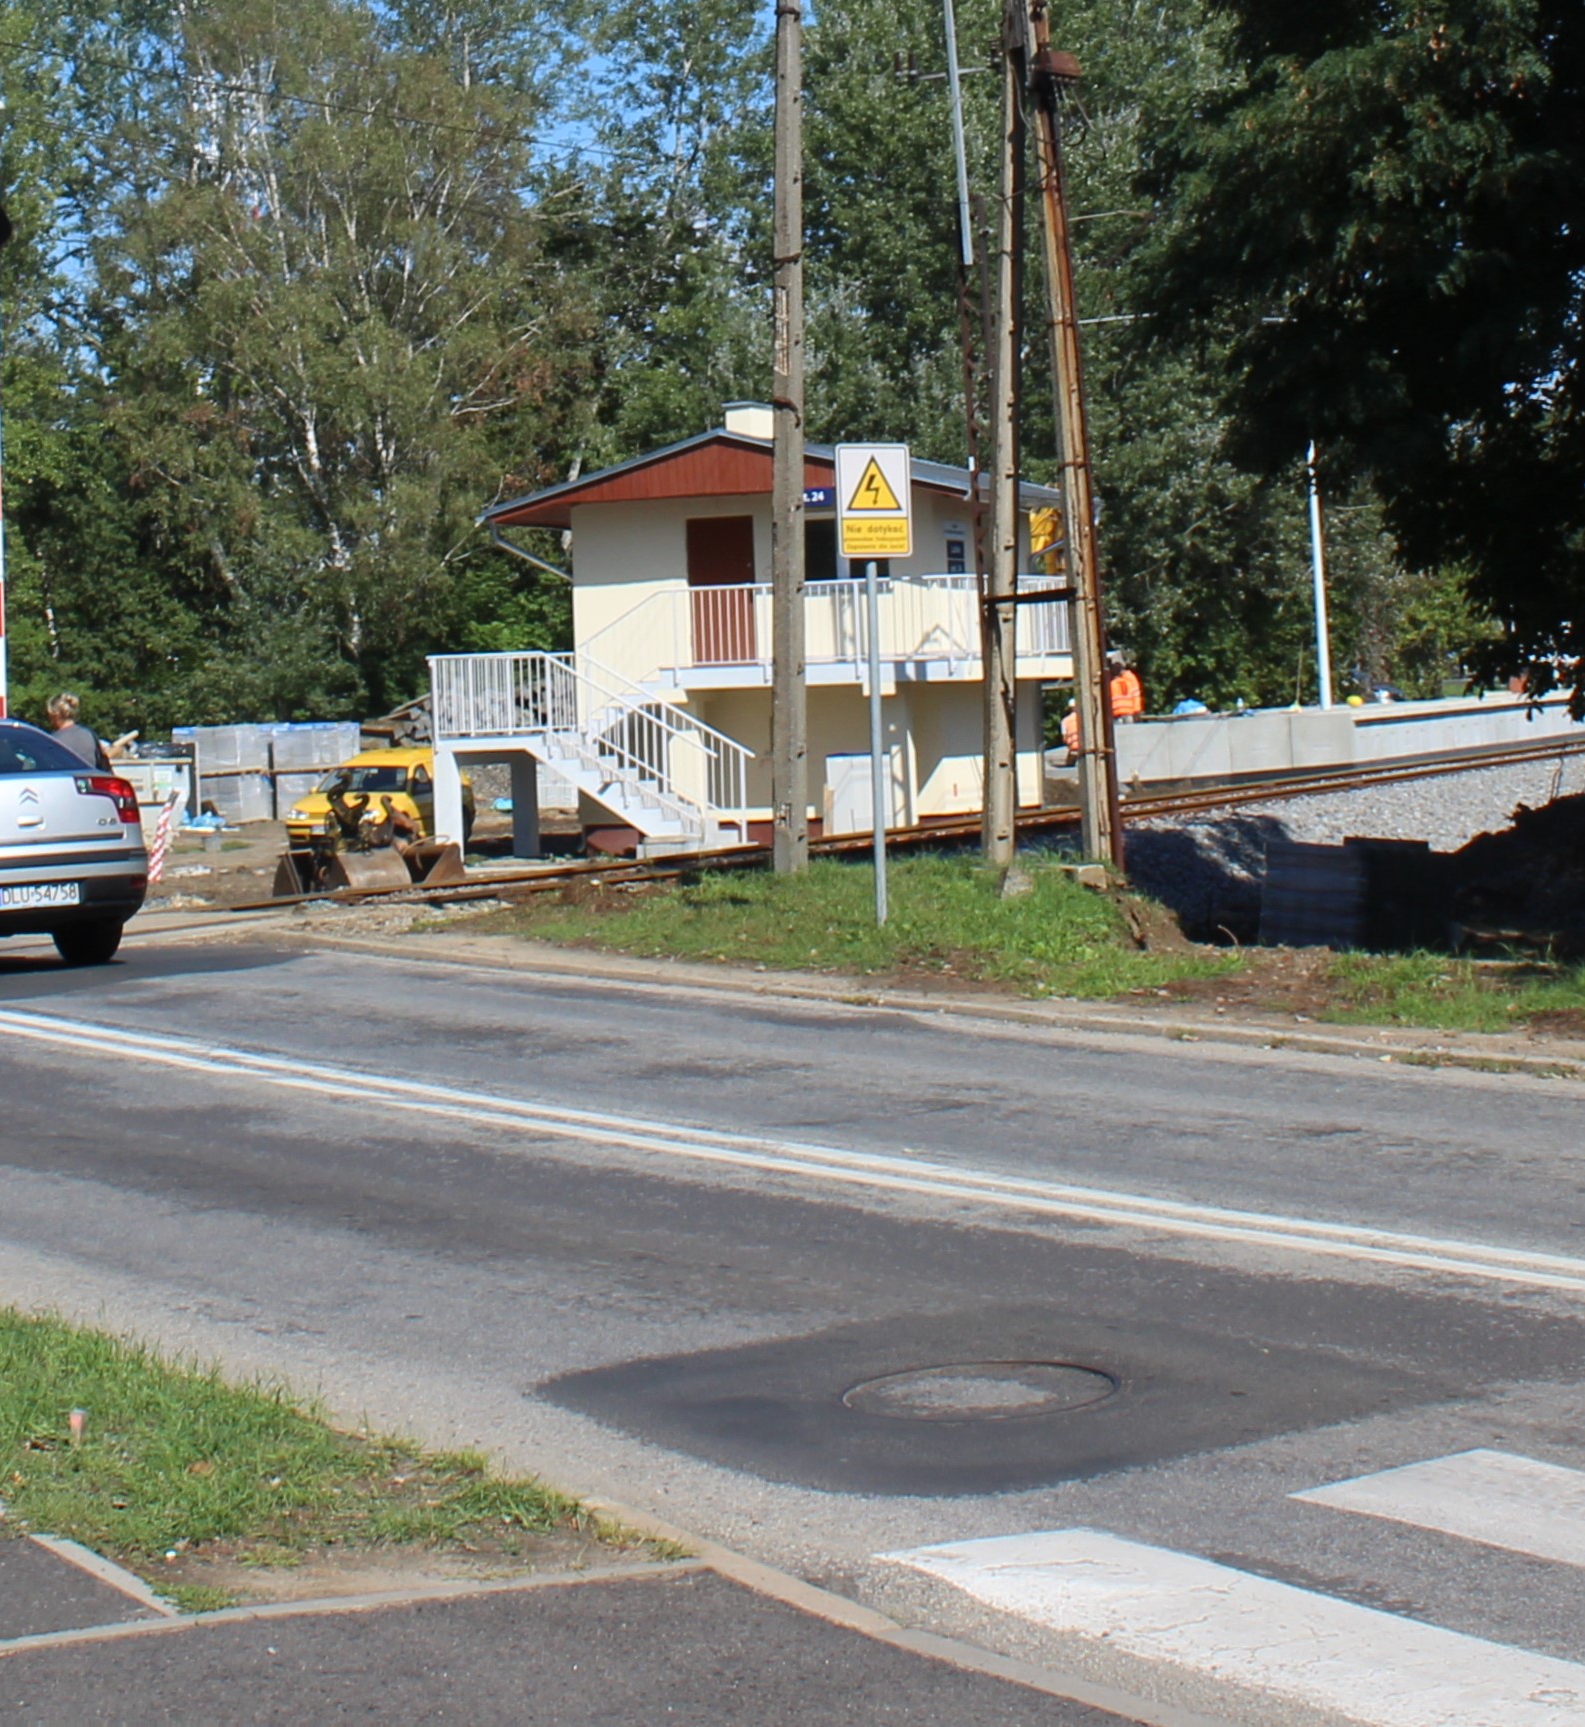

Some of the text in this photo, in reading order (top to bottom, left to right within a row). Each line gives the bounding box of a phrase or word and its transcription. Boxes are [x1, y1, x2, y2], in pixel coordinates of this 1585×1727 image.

[811, 490, 825, 502] 24
[846, 524, 904, 535] Nie dotykać
[2, 883, 77, 905] DLU 54758
